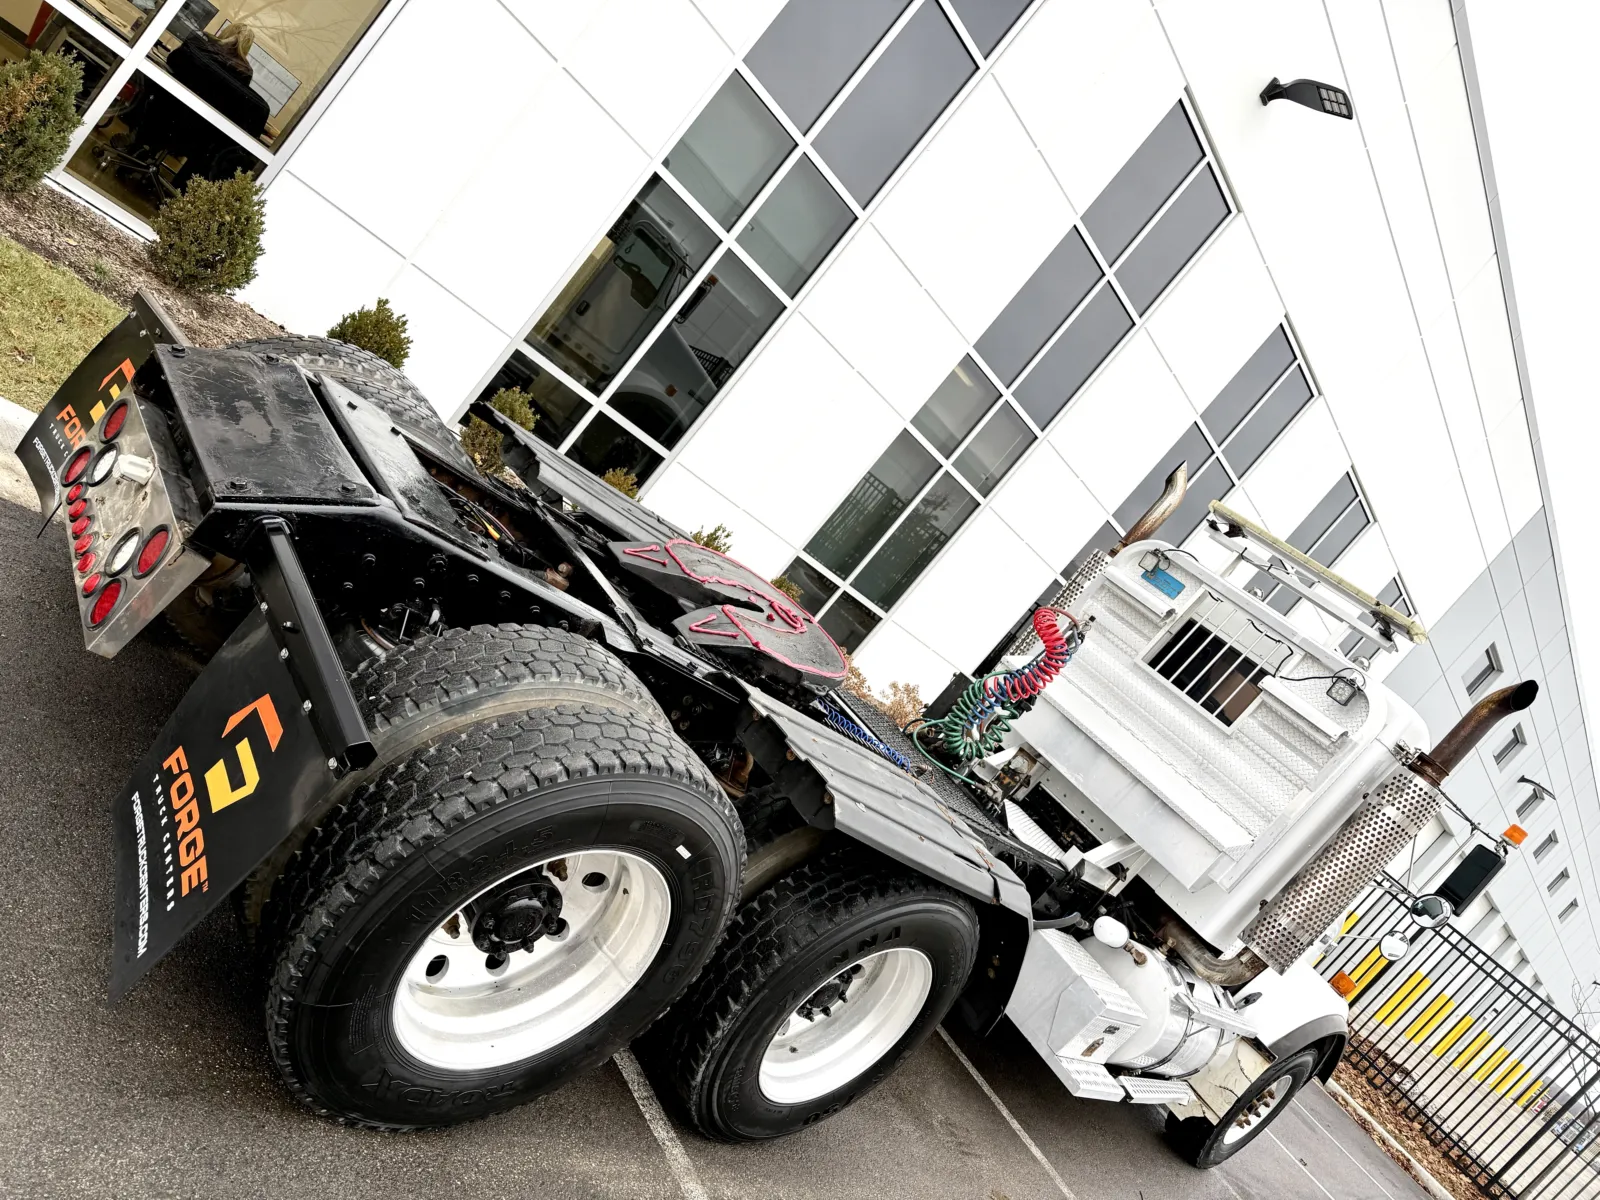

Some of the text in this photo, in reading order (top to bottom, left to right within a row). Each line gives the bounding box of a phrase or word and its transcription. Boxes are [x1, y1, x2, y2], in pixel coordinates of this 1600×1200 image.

[49, 423, 65, 450] TRUCK
[56, 404, 87, 451] FOR
[131, 791, 150, 959] FORGETRUCKCENTERS.COM
[153, 774, 175, 912] TRUCK CENTERS
[163, 746, 208, 897] FORGE
